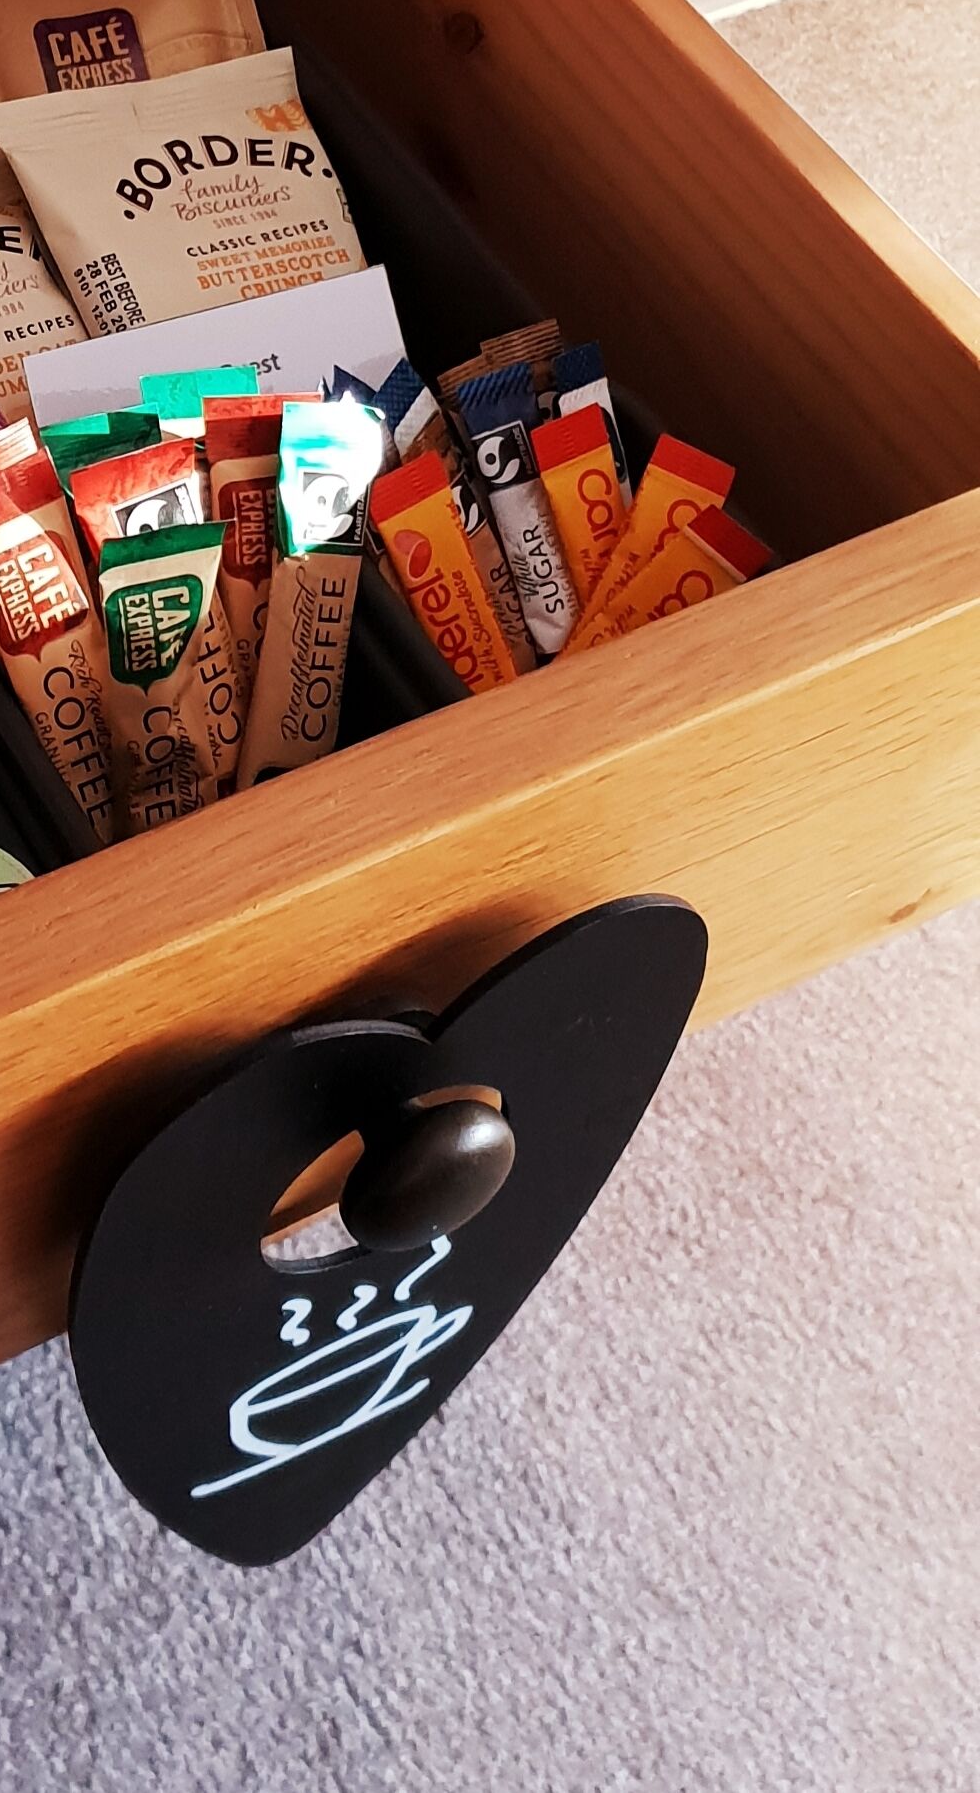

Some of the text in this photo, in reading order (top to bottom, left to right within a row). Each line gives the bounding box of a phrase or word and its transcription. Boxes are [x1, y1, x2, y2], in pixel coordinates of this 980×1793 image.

[47, 17, 129, 67] CAFÉ
[57, 57, 136, 92] EXPRESS
[116, 135, 316, 213] BORDER
[182, 174, 265, 202] family
[186, 219, 330, 258] CLASSIC RECIPES
[196, 235, 336, 271] SWEET MEMORIES
[196, 248, 351, 291] BUTTERSCOTCH
[73, 268, 93, 298] 9101
[86, 260, 102, 279] 28
[95, 279, 117, 313] FEB
[101, 253, 146, 326] BEST BEFORE
[239, 270, 325, 300] CRUNCH
[4, 314, 75, 343] RECIPES
[239, 490, 266, 566] EXPRESS
[18, 543, 82, 629] CAFÉ
[523, 525, 565, 614] SUGAR
[125, 592, 158, 673] EXPRESS
[282, 566, 318, 742] Decaffeinated
[301, 577, 347, 742] COFFEE
[42, 667, 116, 828] COFFEE
[142, 705, 177, 827] COFFE
